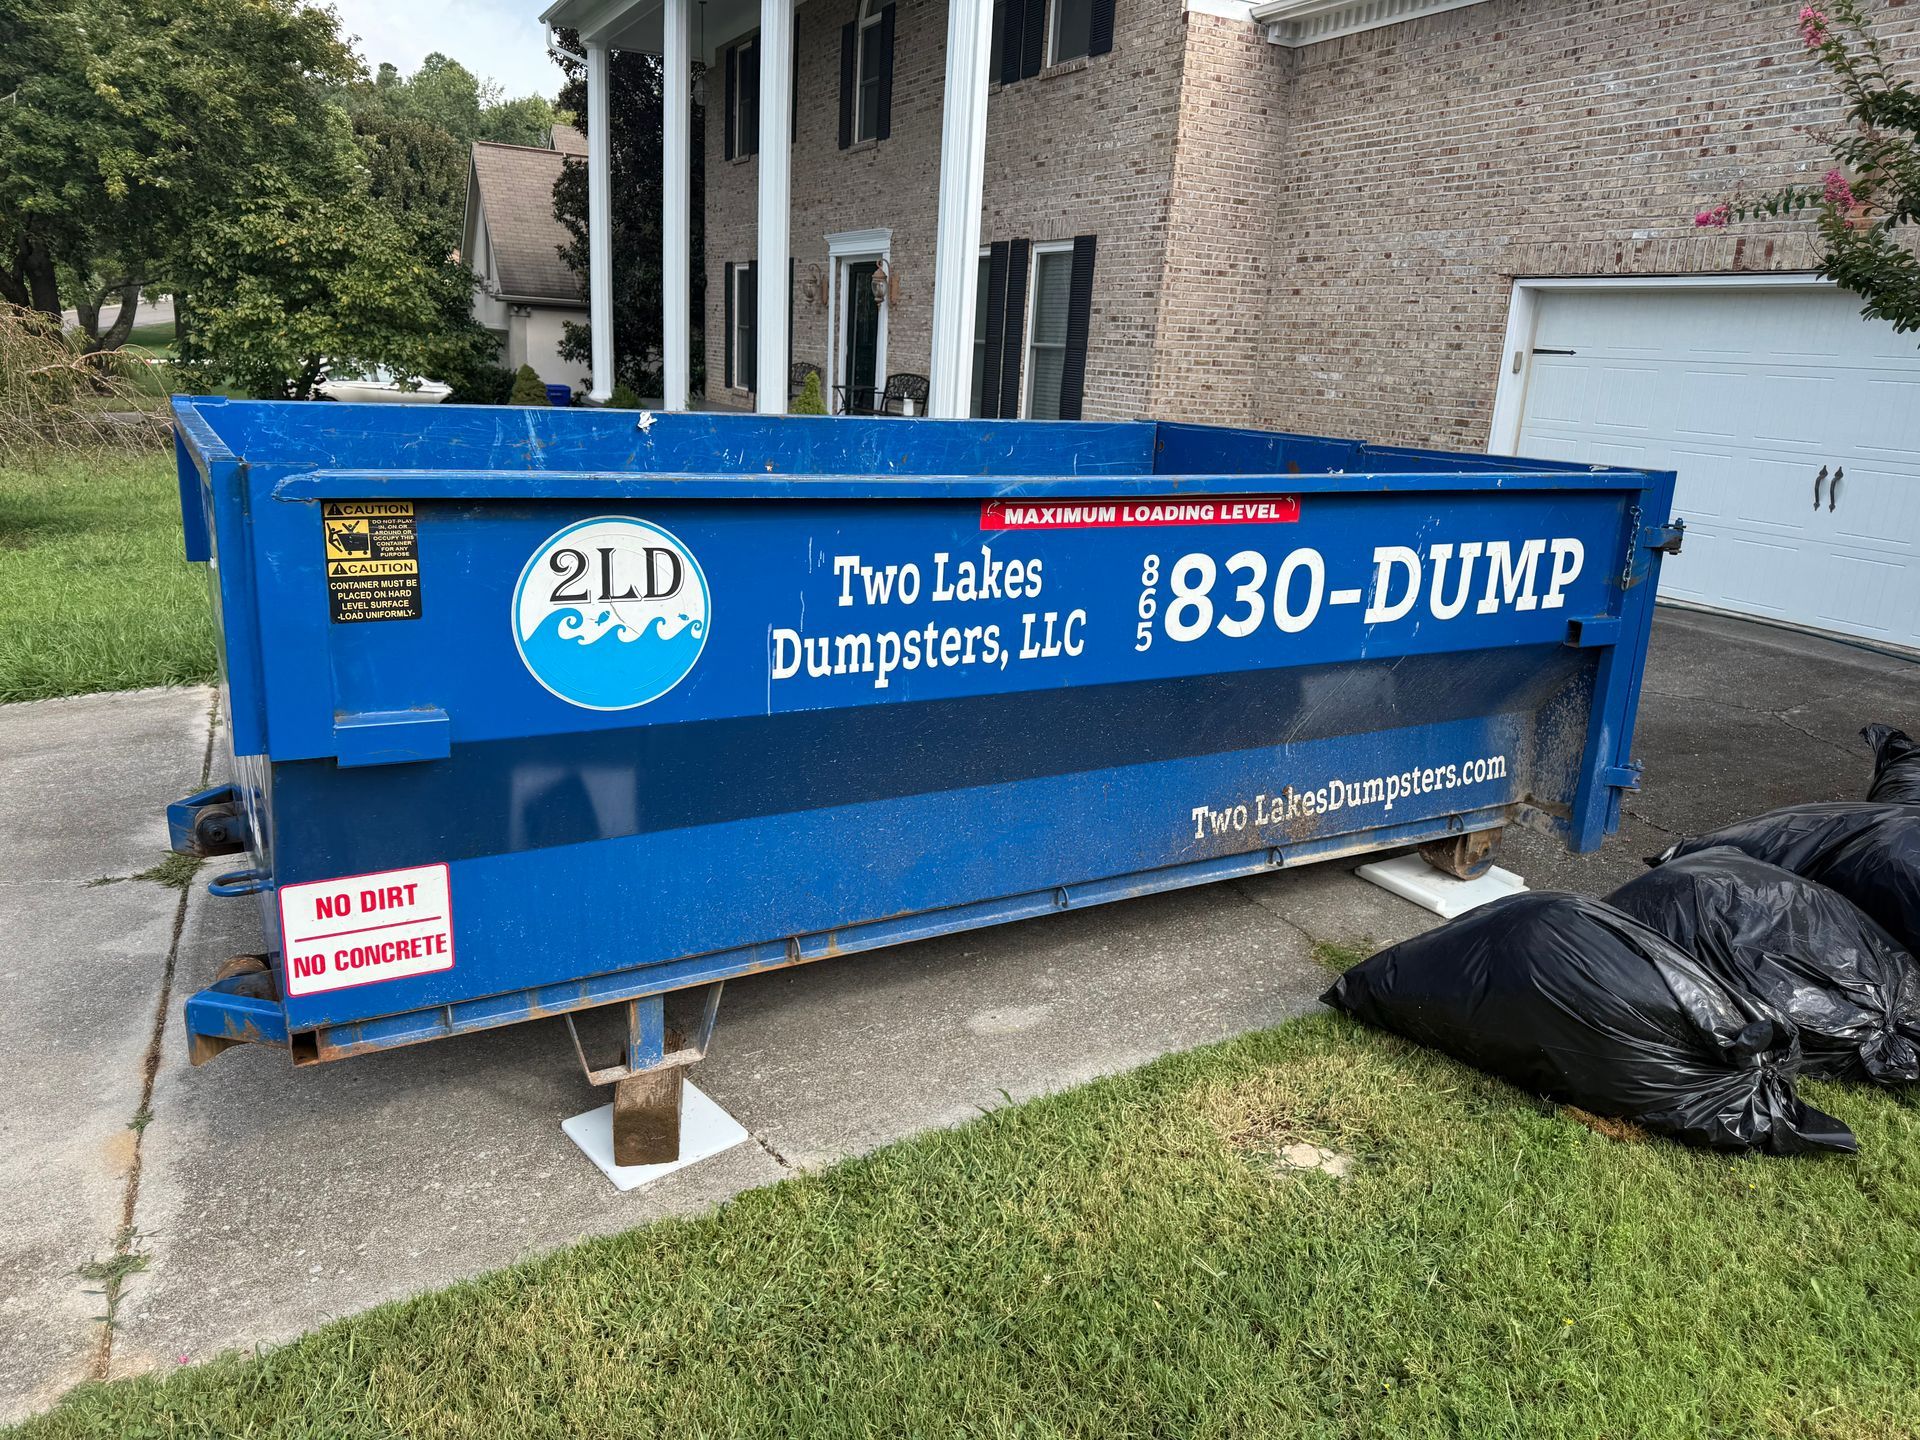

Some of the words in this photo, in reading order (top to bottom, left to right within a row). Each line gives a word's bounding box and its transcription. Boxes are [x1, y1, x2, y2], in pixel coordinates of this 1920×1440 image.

[343, 504, 409, 515] CAUTION
[1004, 505, 1116, 525] MAXIMUM
[1122, 504, 1215, 522] LOADING
[1220, 503, 1281, 520] LEVEL
[330, 582, 380, 591] CONTAINER
[381, 580, 404, 588] MUST
[406, 579, 418, 587] BE
[348, 563, 413, 573] CAUTION
[549, 547, 686, 606] 2LD
[833, 554, 921, 607] Two
[931, 545, 1043, 603] Lakes
[338, 591, 372, 601] PLACED
[373, 591, 387, 599] ON
[388, 590, 412, 598] HARD
[341, 602, 369, 611] LEVEL
[370, 600, 410, 609] SURFACE
[1164, 537, 1585, 643] 830-DUMP
[772, 619, 1010, 689] Dumpsters,
[1018, 608, 1087, 660] LLC
[1191, 804, 1248, 839] Two
[315, 893, 351, 920] NO
[360, 883, 418, 913] DIRT
[293, 953, 326, 978] NO
[334, 933, 447, 972] CONCRETE
